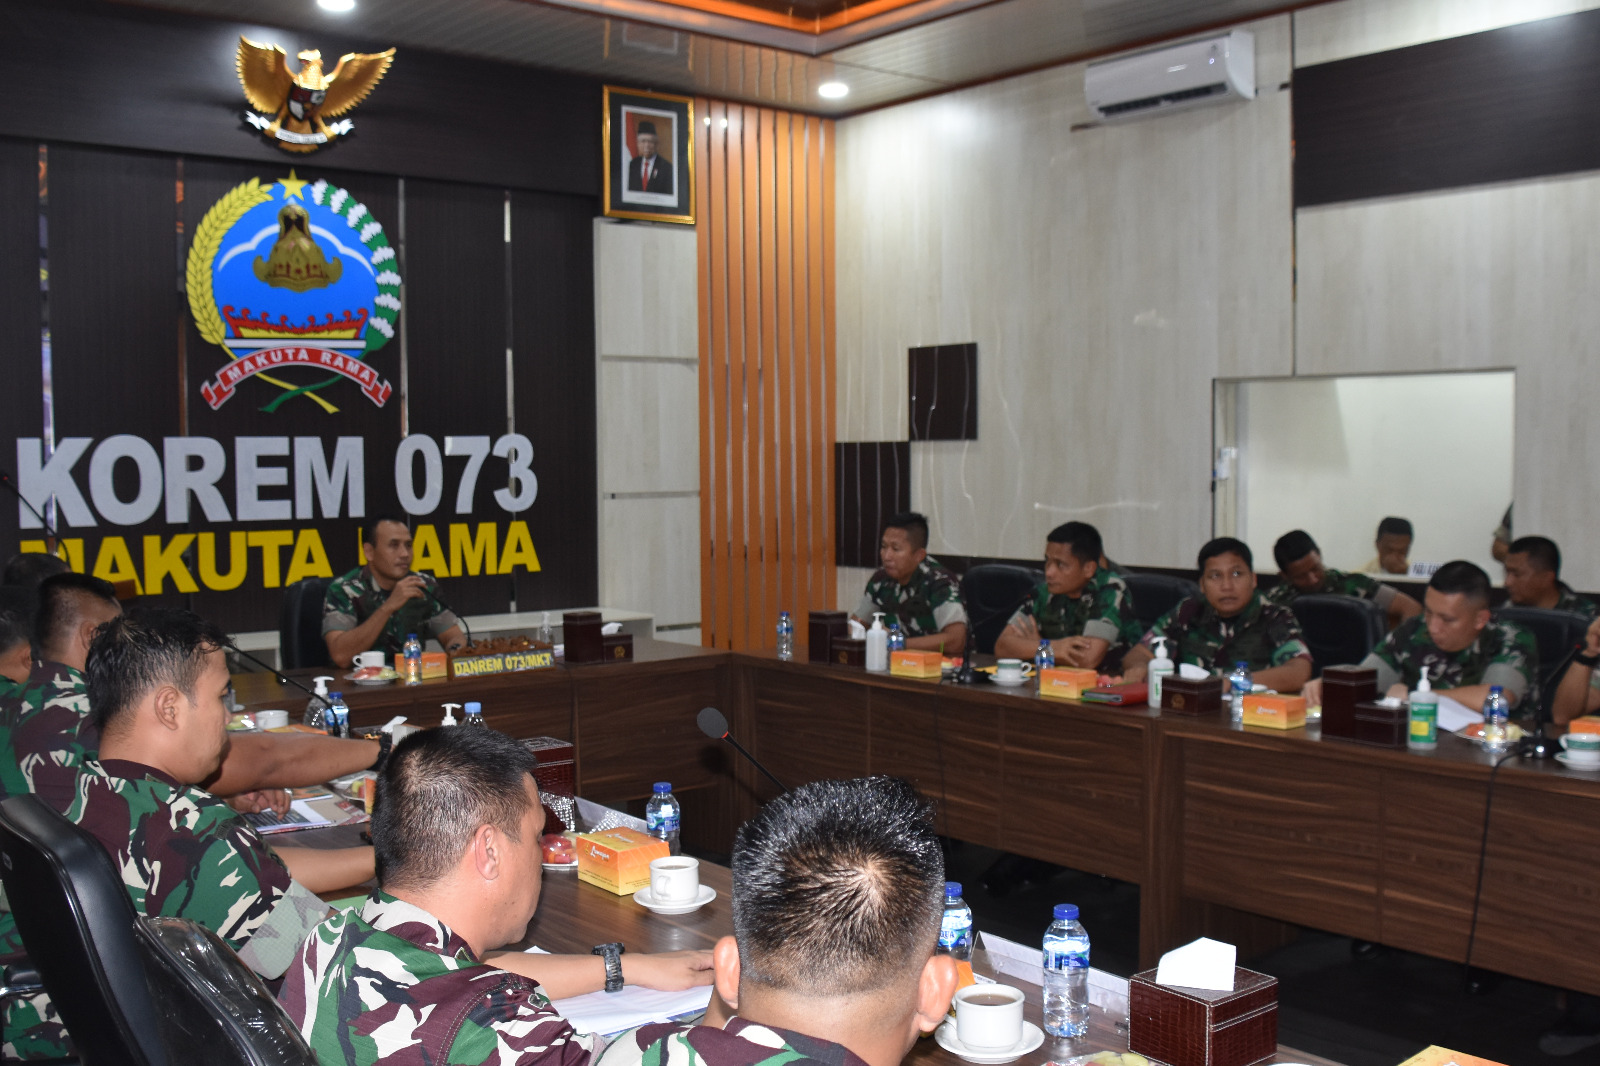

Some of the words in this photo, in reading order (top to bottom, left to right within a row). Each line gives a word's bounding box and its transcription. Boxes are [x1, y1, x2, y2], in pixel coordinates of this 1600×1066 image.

[226, 349, 309, 381] MAKUTA
[320, 352, 371, 382] RAMA
[16, 434, 366, 529] KOREM
[395, 433, 538, 516] 073
[358, 520, 541, 578] AMA
[453, 658, 503, 676] DANREM
[504, 652, 552, 670] 073/MKT
